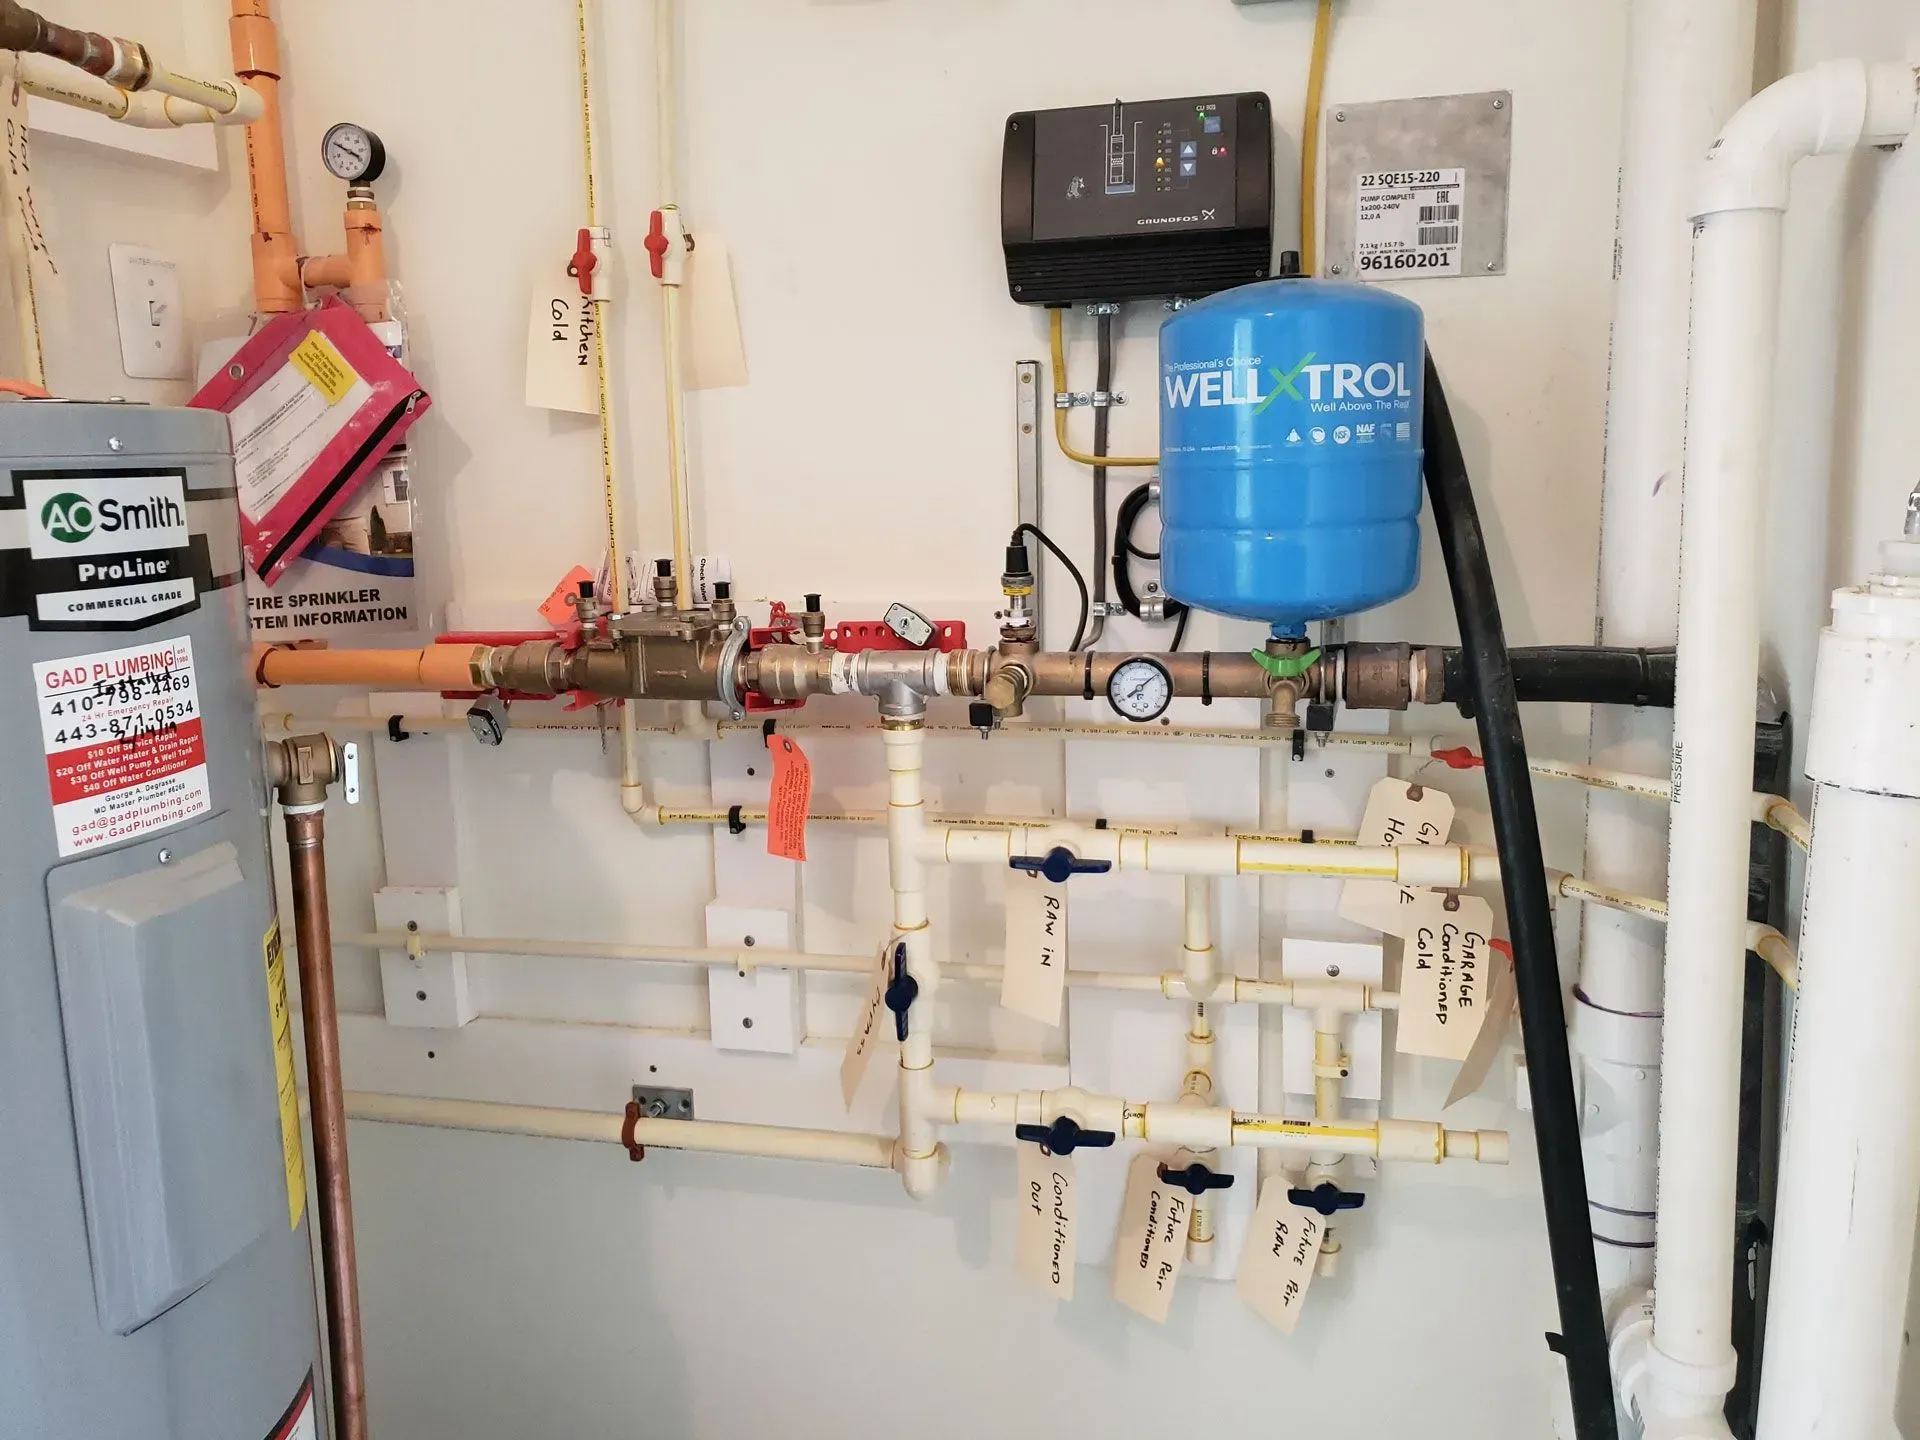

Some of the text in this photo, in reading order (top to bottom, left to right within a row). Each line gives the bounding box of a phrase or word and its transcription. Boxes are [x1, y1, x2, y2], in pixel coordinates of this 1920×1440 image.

[1361, 171, 1440, 187] 22 SQE15-220
[1361, 203, 1400, 211] 1x200-240V
[1381, 193, 1415, 201] COMPLETE
[1137, 215, 1199, 225] GRUNDFOS
[1361, 252, 1450, 270] 96160201
[552, 298, 569, 342] Cold
[1174, 358, 1224, 372] Professional's
[1311, 402, 1336, 413] Well
[1338, 401, 1372, 412] Above
[1375, 400, 1392, 410] The
[1356, 423, 1375, 433] NAF
[98, 496, 181, 532] Smith
[78, 558, 167, 582] ProLine
[699, 558, 707, 581] Check
[68, 591, 182, 612] COMMERCIAL GRADE
[248, 589, 381, 610] FIRE SPRINKLER
[293, 606, 408, 627] INFORMATION
[45, 667, 87, 689] GAD
[93, 650, 174, 681] PLUMBING
[107, 703, 151, 718] Emergency
[152, 696, 174, 707] Repair
[55, 700, 194, 744] 443-871-0534
[56, 768, 73, 778] $20
[76, 762, 91, 773] Off
[94, 757, 120, 769] Water
[122, 750, 150, 762] Heater
[158, 742, 178, 753] Drain
[179, 734, 199, 749] Repair
[87, 749, 104, 760] $10
[106, 743, 121, 755] Off
[123, 737, 152, 752] Sevice
[70, 774, 87, 785] $30
[90, 769, 105, 780] Off
[107, 763, 126, 776] Well
[129, 758, 152, 771] Pump
[161, 751, 177, 762] Well
[178, 746, 193, 758] Tank
[83, 759, 188, 793] $40 Off Water Conditioner
[1674, 741, 1684, 803] PRESSURE
[105, 790, 133, 803] George
[145, 778, 176, 792] Degrasse
[109, 799, 135, 811] Master
[138, 790, 166, 803] Plumber
[72, 788, 202, 835] gad@gadplumbing.com
[73, 801, 204, 847] www.GadPlumbing.com
[1416, 927, 1433, 970] Cold
[1459, 931, 1486, 1008] GARAGE
